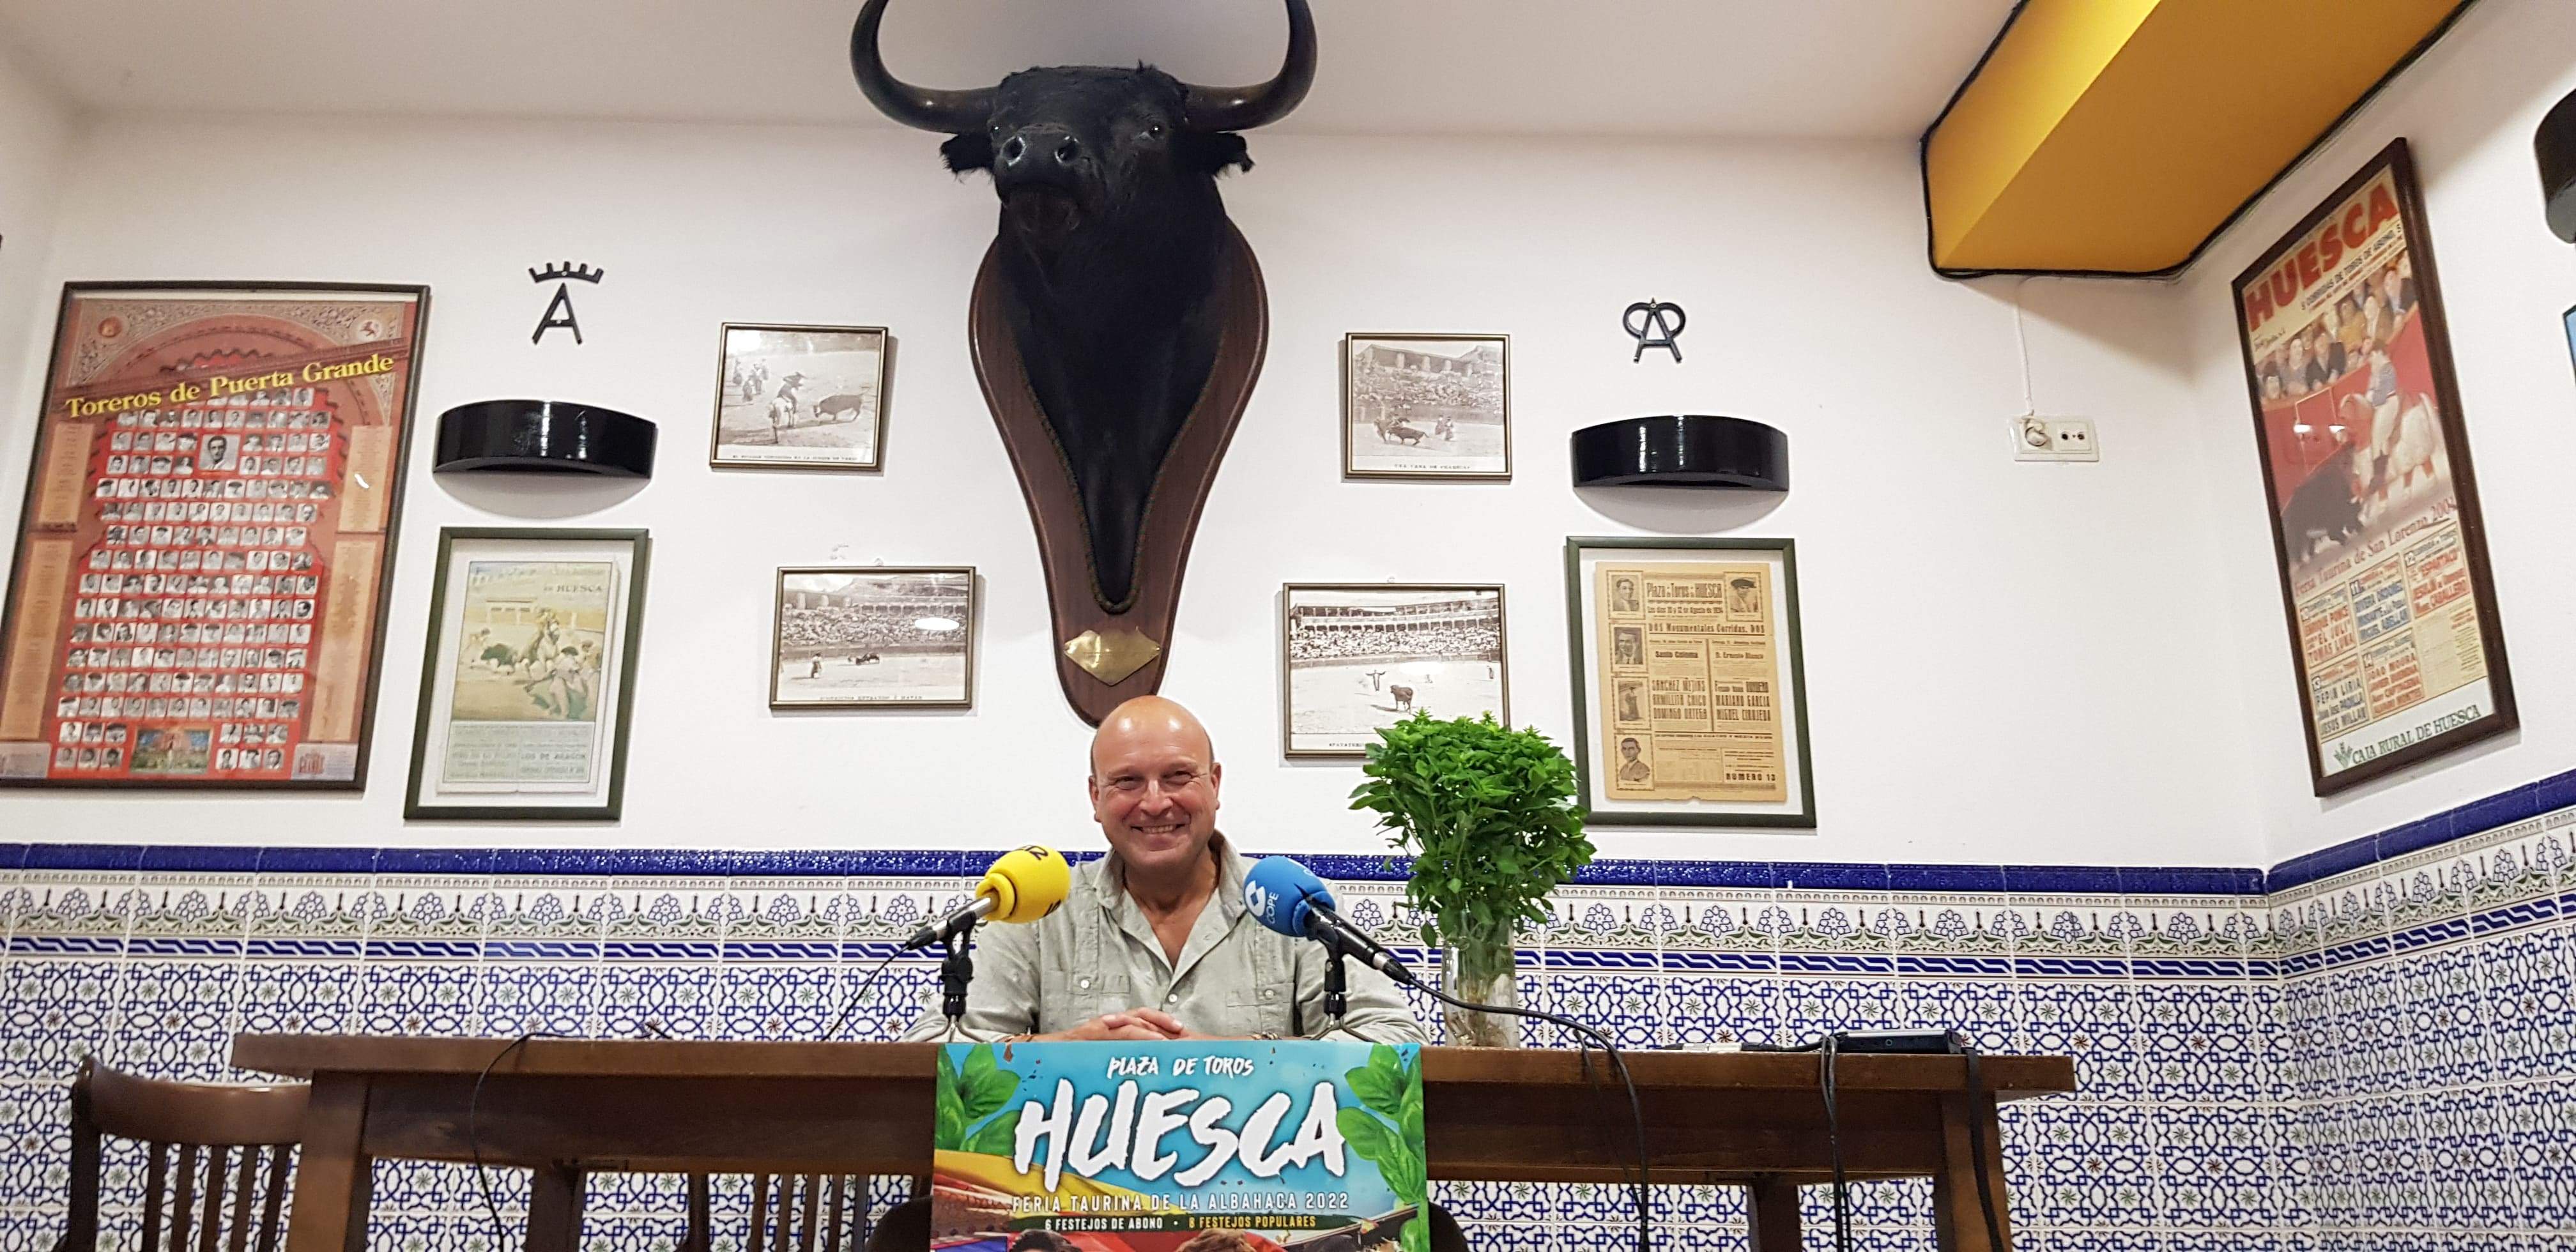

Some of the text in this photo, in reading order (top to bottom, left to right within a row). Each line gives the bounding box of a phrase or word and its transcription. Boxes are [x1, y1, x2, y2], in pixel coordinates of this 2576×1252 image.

[2246, 183, 2399, 332] HUESCA
[65, 354, 395, 418] Toreros de Puerta Grande
[2378, 730, 2415, 754] RURAL
[2415, 722, 2433, 741] DE
[2433, 704, 2481, 735] HUESCA
[1266, 891, 1279, 924] COPE
[1107, 1055, 1254, 1080] PLAZA DE TOROS
[1014, 1078, 1347, 1193] HUESCA
[1013, 1192, 1349, 1212] FERIA TAURINA DE LA ALBAHACA 2022
[1045, 1217, 1163, 1230] 6 FESTEJOS DE ABONO
[1189, 1216, 1316, 1228] 8 FESTEJOS POPULARES
